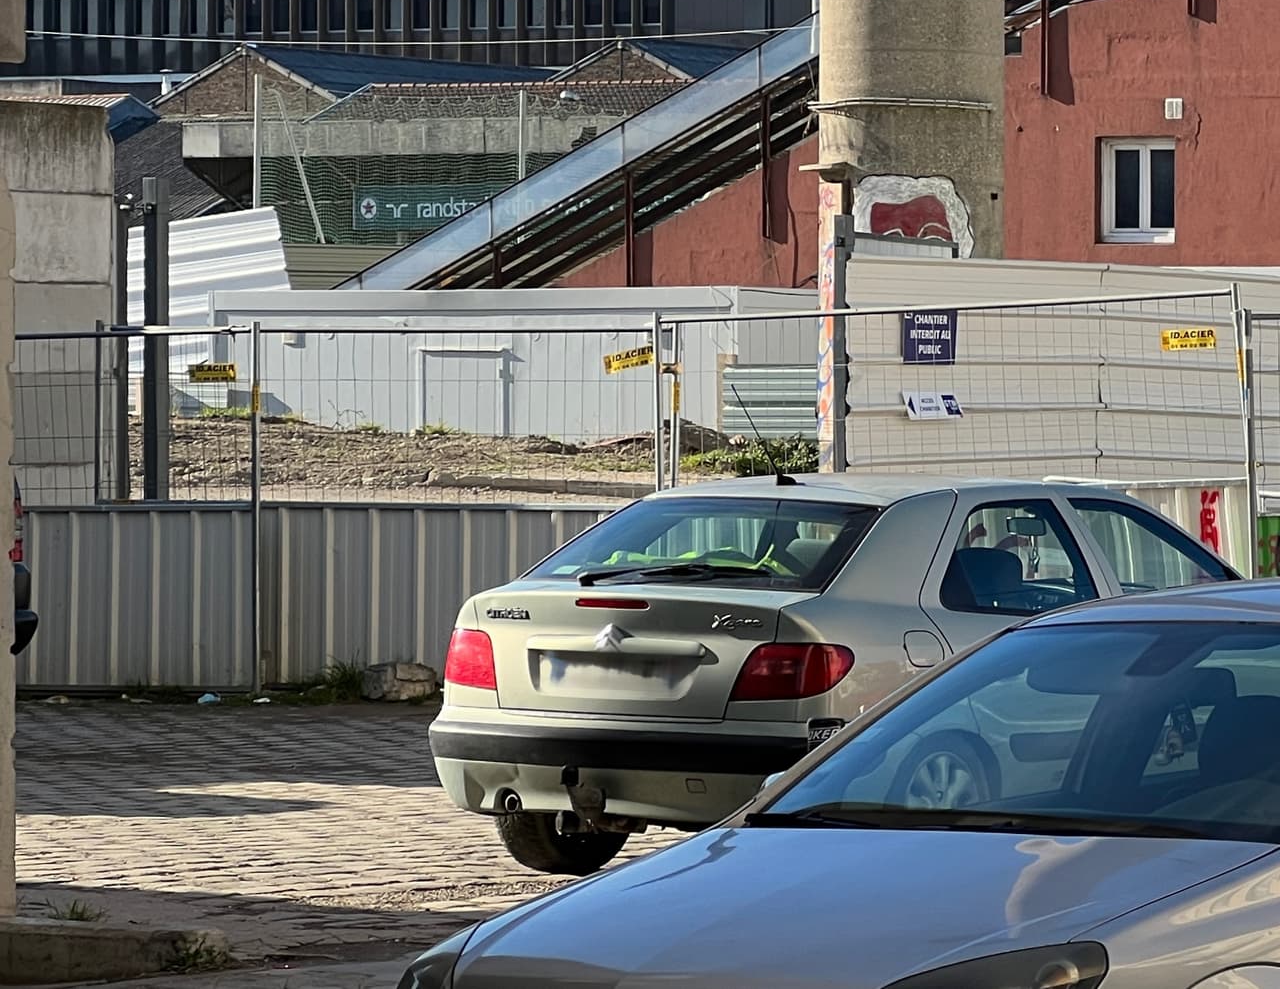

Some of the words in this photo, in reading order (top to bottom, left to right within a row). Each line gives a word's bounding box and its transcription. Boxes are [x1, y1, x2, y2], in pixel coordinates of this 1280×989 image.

[914, 314, 948, 325] CHANTIER
[910, 329, 940, 340] INTERDIT
[940, 330, 951, 340] AU
[1170, 329, 1215, 339] ID.ACIER
[918, 344, 942, 355] PUBLIC
